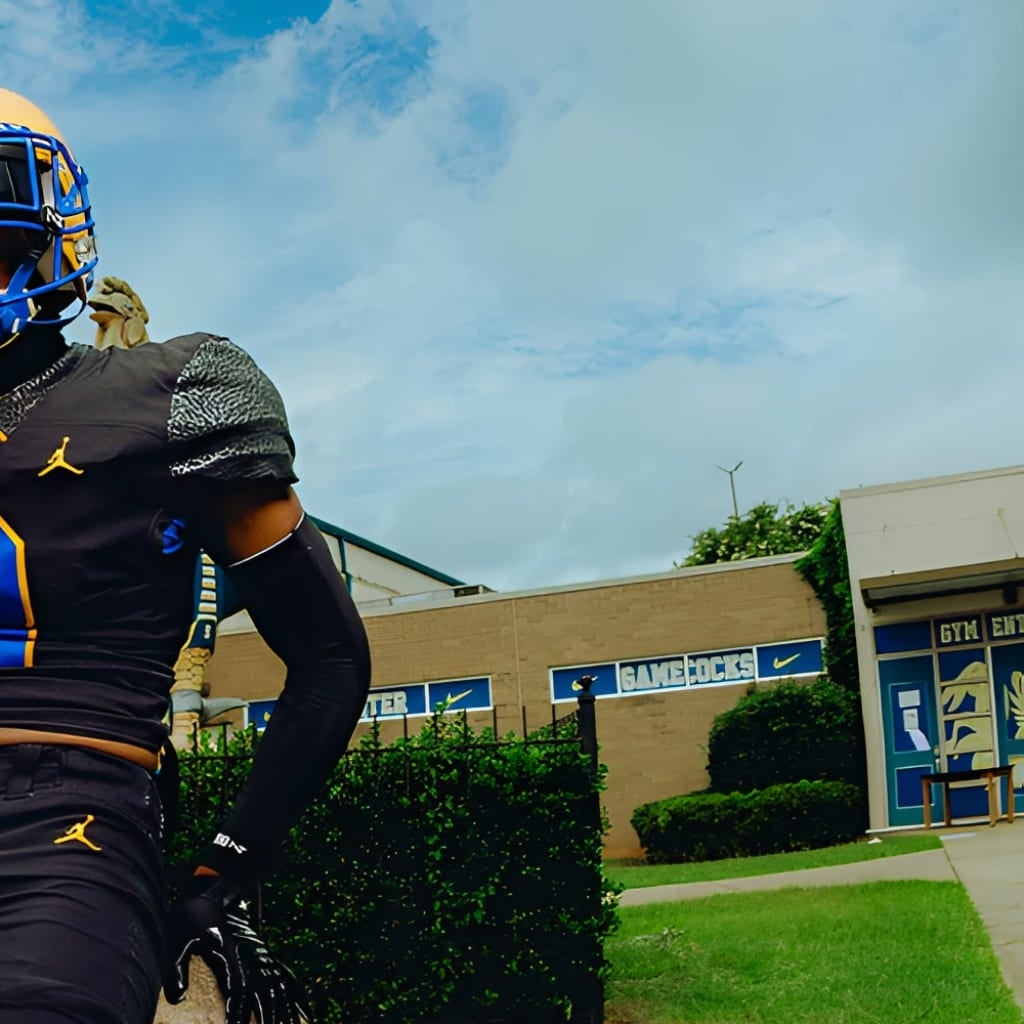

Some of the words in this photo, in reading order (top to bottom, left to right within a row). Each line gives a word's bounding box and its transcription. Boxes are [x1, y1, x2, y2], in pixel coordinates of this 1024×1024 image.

[940, 620, 980, 643] GYM
[620, 652, 754, 691] GAMECOCKS
[362, 690, 408, 719] TER
